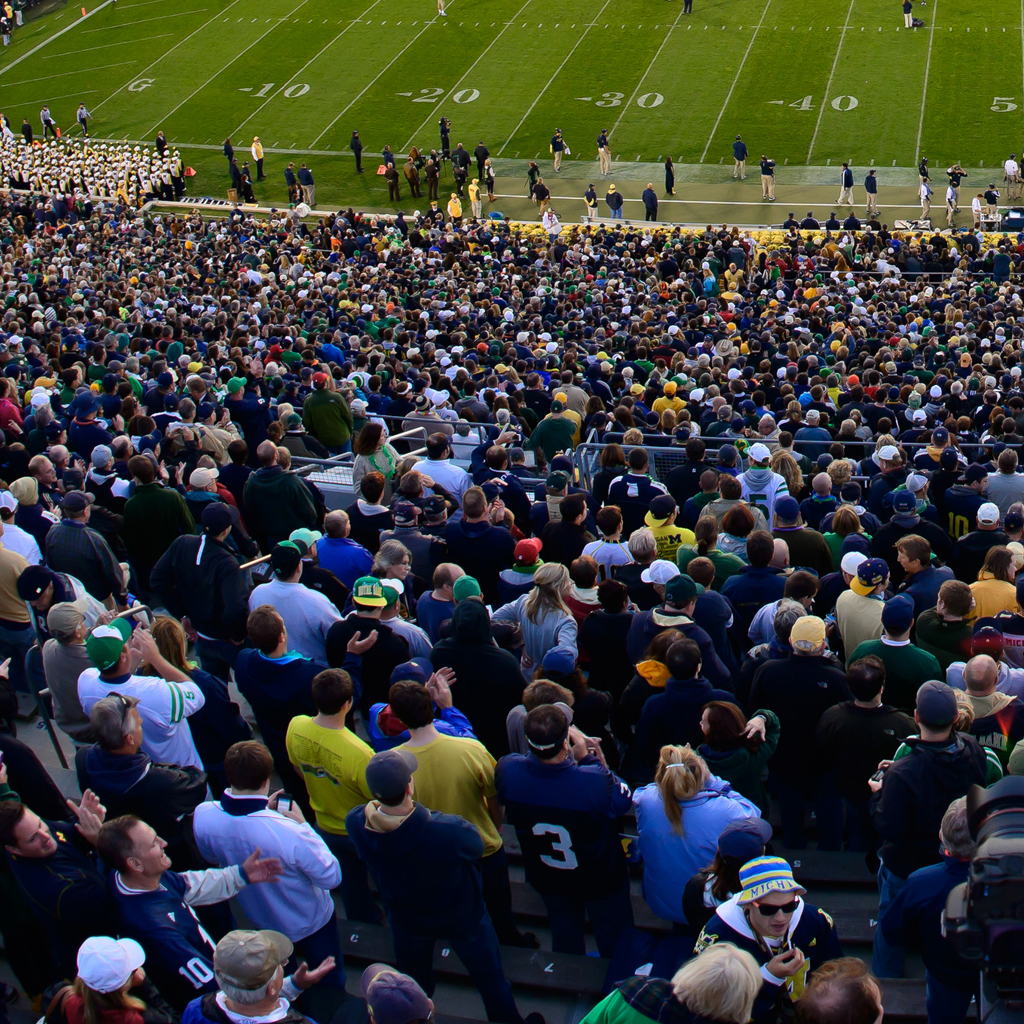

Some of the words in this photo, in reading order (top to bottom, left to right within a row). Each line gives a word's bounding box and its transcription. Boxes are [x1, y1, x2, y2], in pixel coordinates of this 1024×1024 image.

[127, 78, 156, 92] G
[249, 82, 311, 98] 10
[411, 87, 481, 104] 20
[595, 91, 665, 109] 30
[788, 95, 859, 112] 40
[948, 511, 970, 539] 10
[668, 533, 683, 545] M
[531, 822, 579, 870] 3
[178, 956, 215, 990] 10
